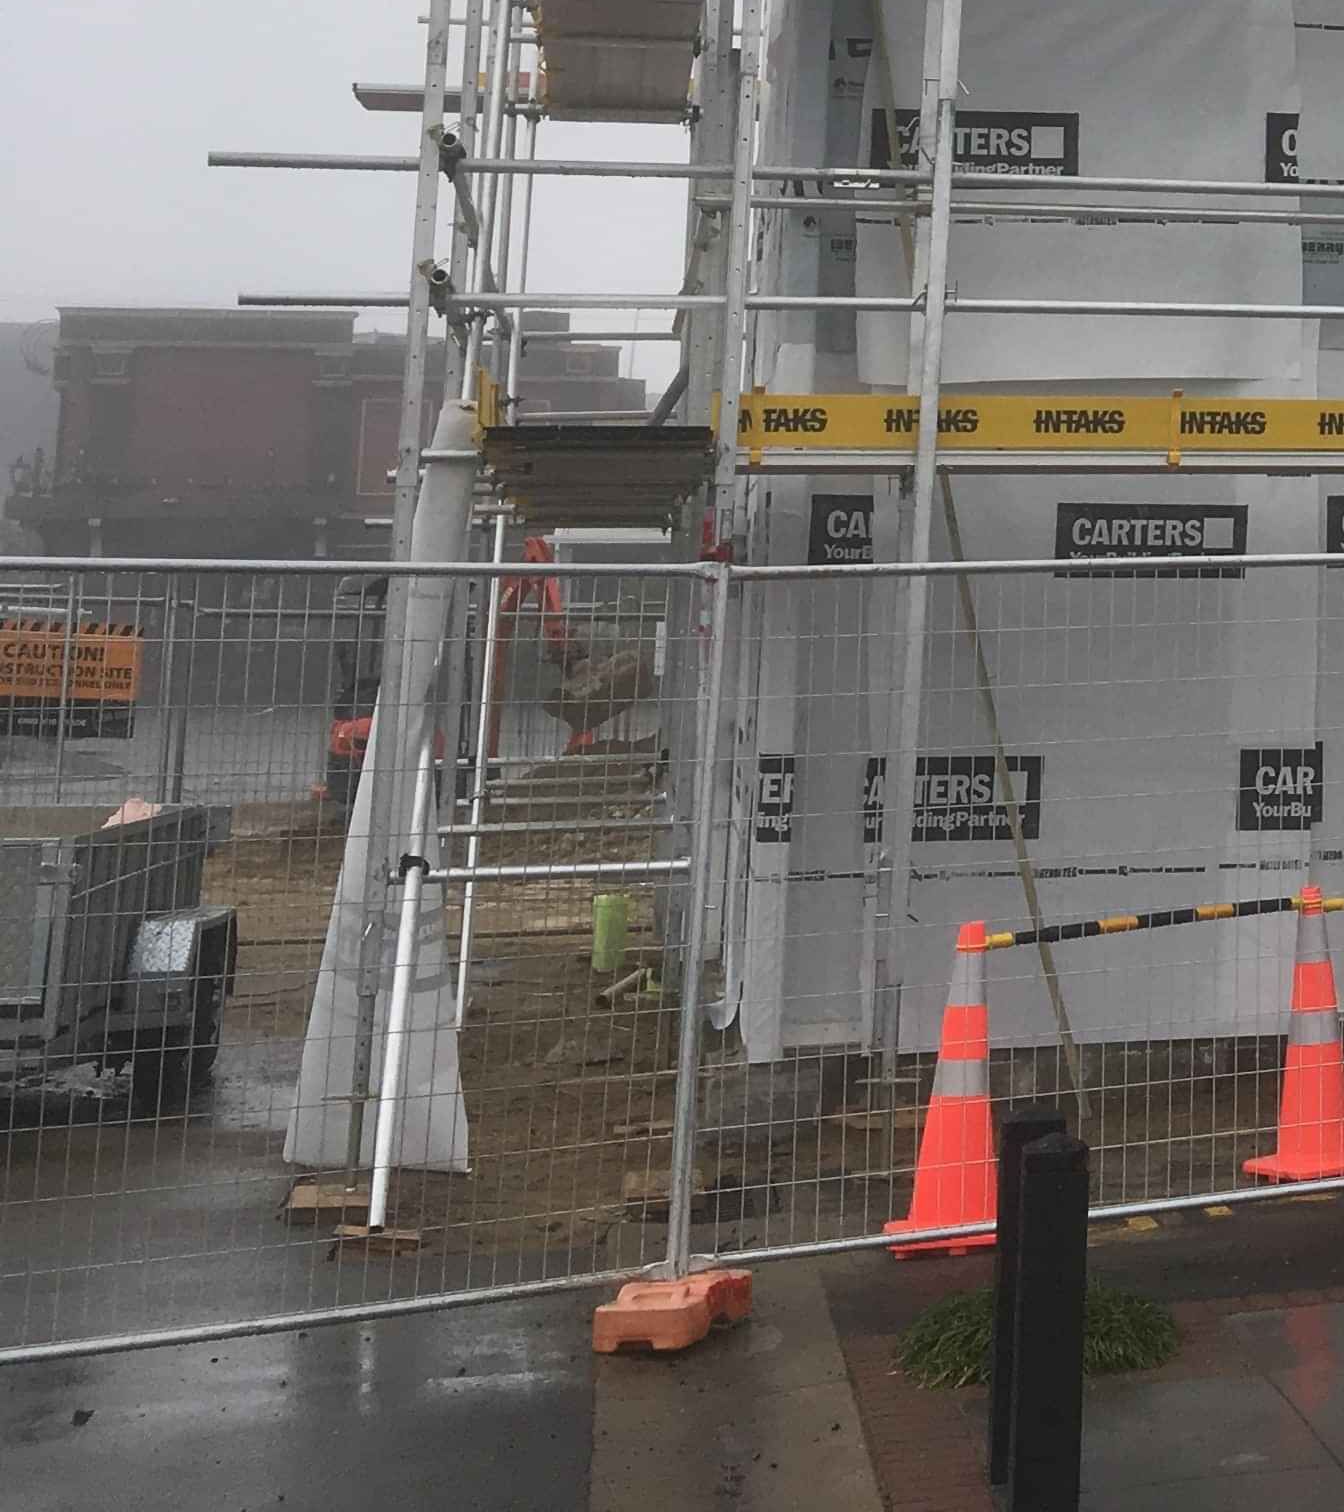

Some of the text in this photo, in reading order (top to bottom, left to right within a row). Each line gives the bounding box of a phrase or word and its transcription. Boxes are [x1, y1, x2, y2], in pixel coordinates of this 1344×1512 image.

[896, 126, 1031, 156] CATERS
[738, 408, 828, 433] NTAKS
[883, 408, 979, 433] INKS
[1034, 409, 1126, 434] INTAKS
[1180, 409, 1267, 435] INTAKS
[1072, 517, 1201, 546] CARTERS
[864, 773, 991, 805] ATERS
